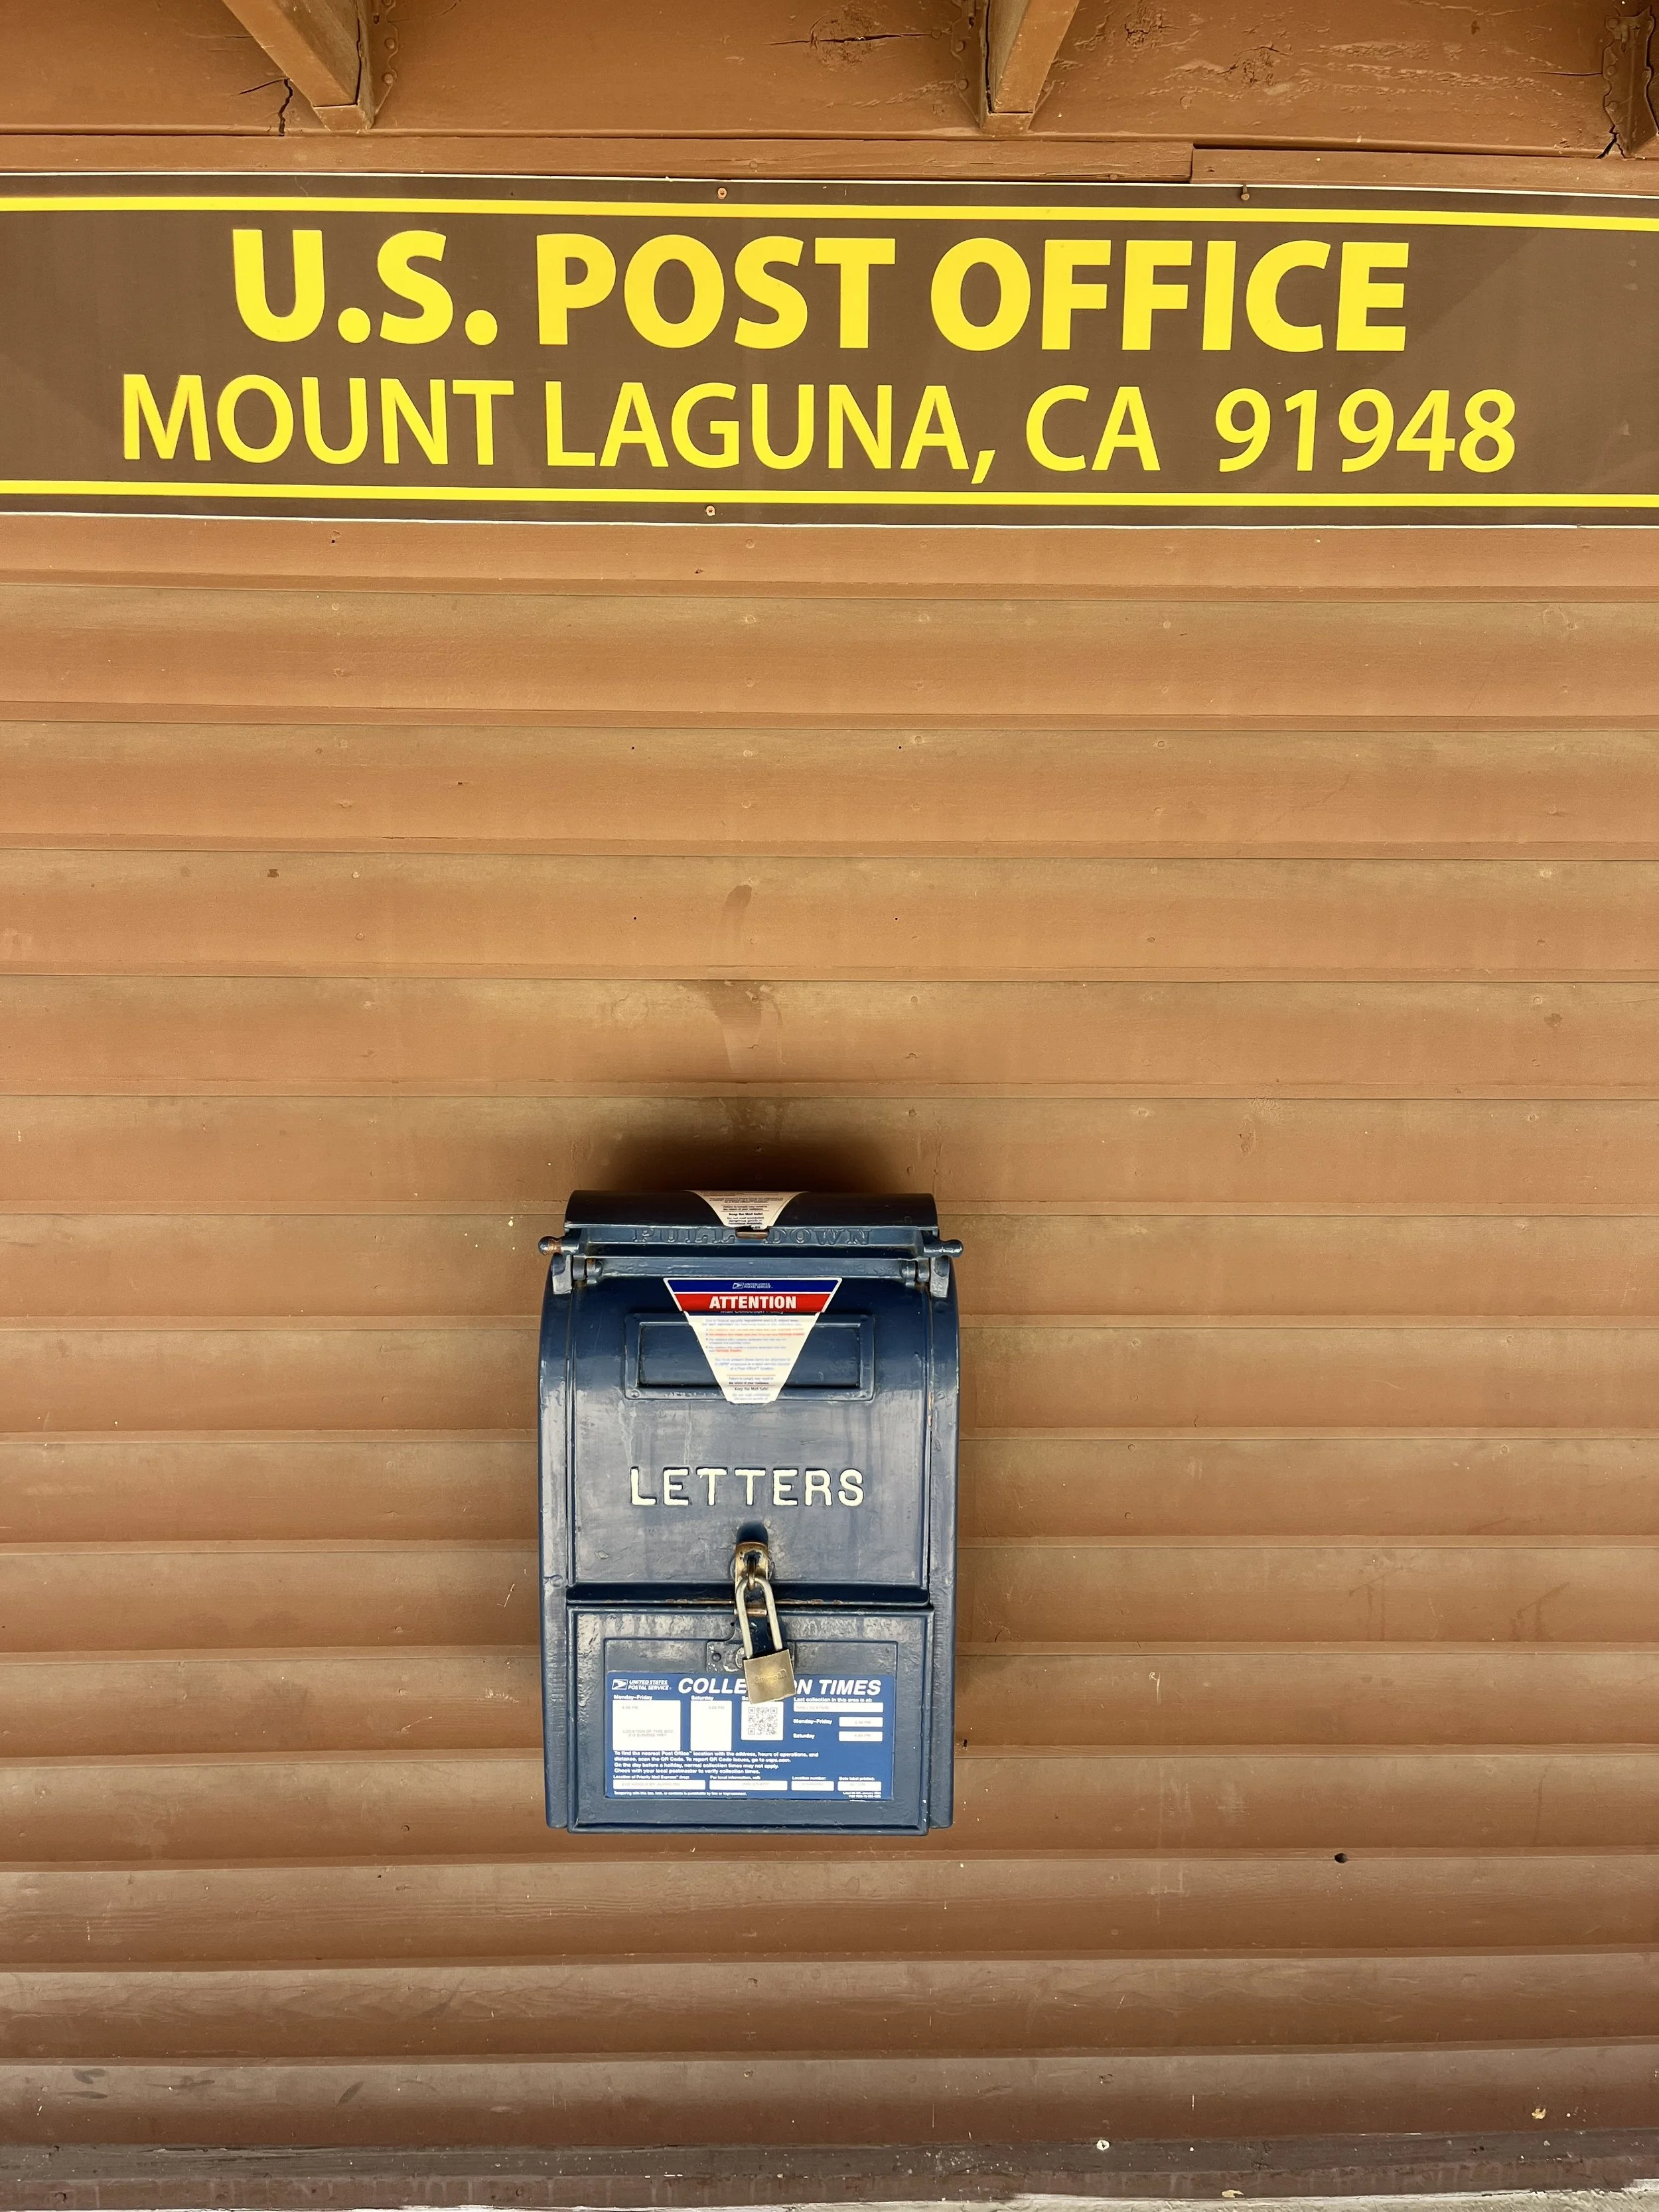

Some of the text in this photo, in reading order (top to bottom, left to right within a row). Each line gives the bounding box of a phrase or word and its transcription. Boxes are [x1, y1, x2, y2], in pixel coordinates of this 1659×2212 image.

[233, 230, 1409, 352] U.S. POST OFFICE
[123, 375, 1514, 484] MOUNT LAGUNA, CA 91948
[632, 1228, 872, 1244] PULL DOWN
[709, 1295, 796, 1309] ATTENTION
[630, 1466, 864, 1507] LETTERS
[678, 1678, 882, 1696] COLLEN TIMES
